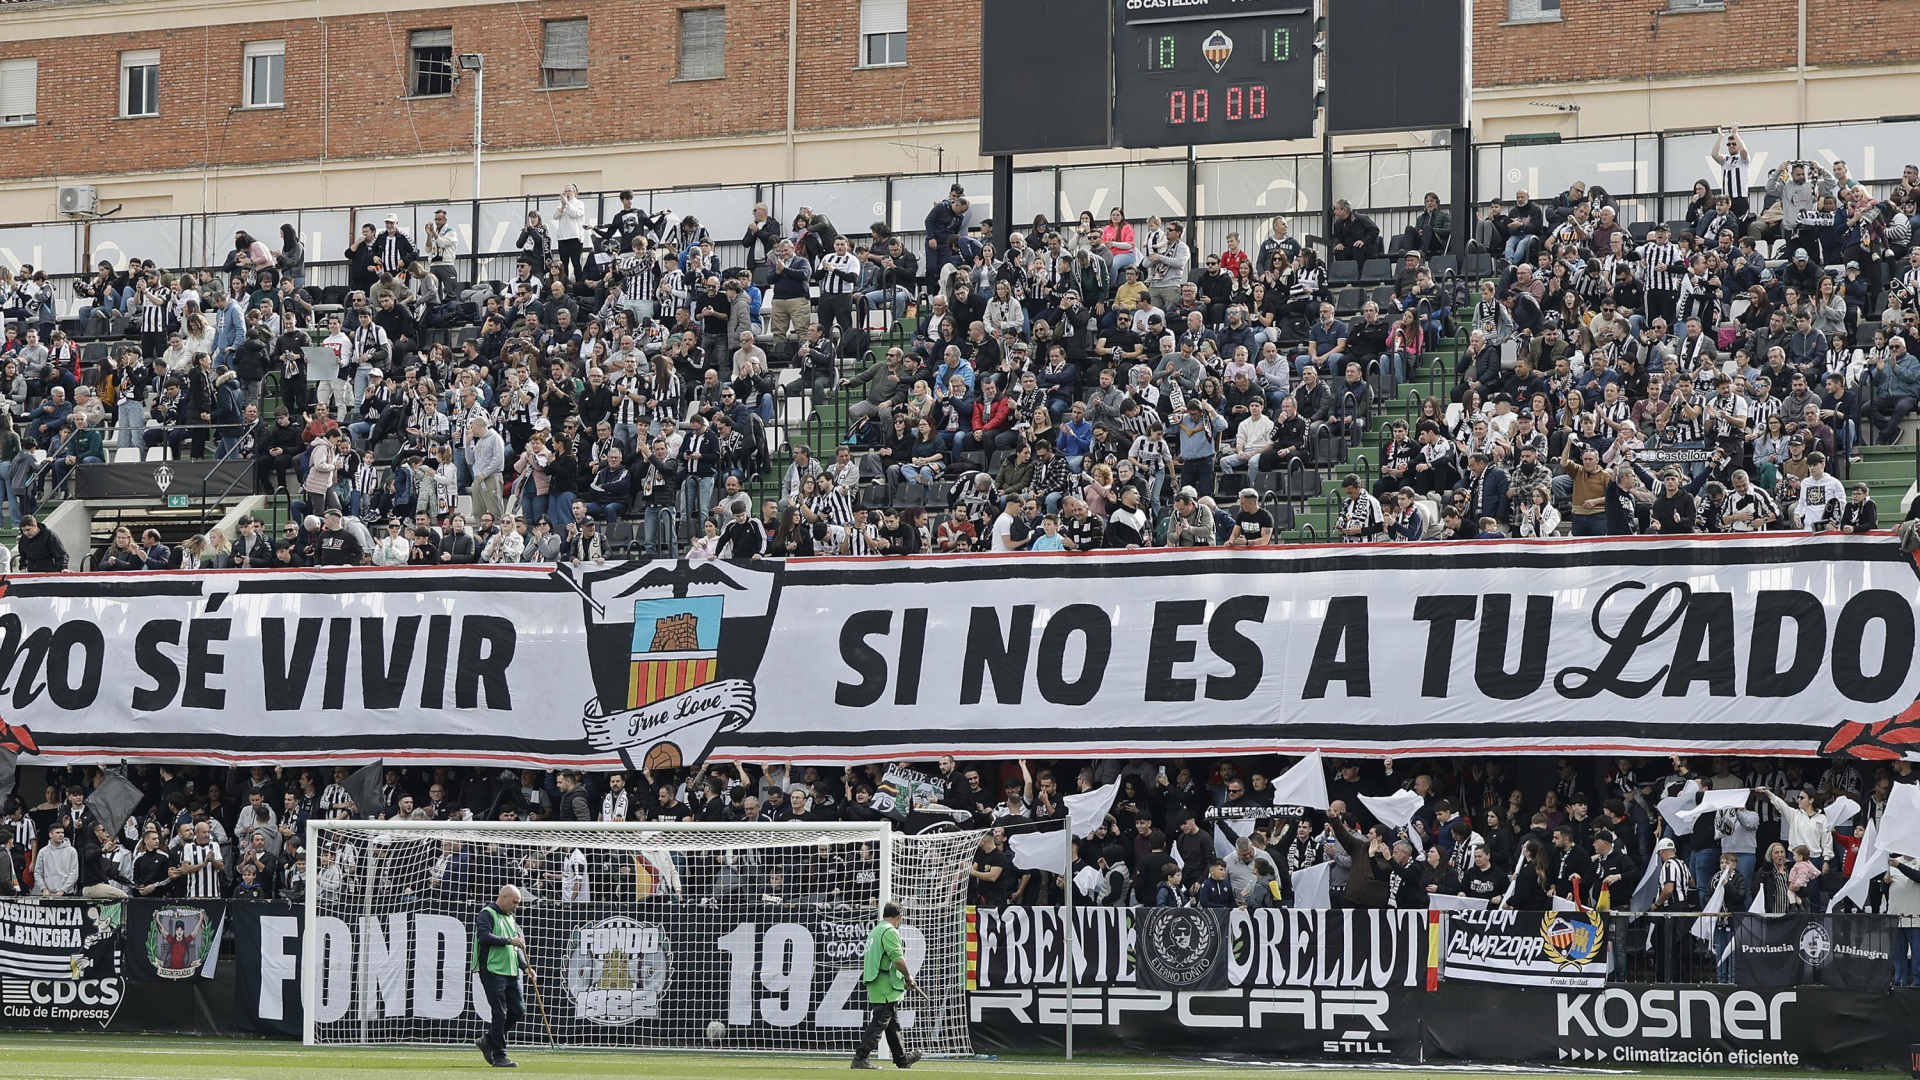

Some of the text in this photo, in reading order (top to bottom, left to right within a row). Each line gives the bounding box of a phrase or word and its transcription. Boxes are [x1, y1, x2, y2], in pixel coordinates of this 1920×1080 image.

[1126, 0, 1142, 10] CD
[1159, 36, 1174, 68] 0
[1274, 28, 1289, 61] 0
[132, 592, 232, 711] SÉ
[260, 615, 517, 711] VIVIR
[834, 580, 1916, 708] SI NO ES A TU LADO
[627, 693, 722, 737] True Love
[887, 763, 927, 783] FRENTE
[1204, 806, 1219, 818] MI
[580, 927, 659, 955] FONDO
[978, 906, 1136, 988] FRENTE
[1447, 929, 1545, 966] ALMAZORA
[1741, 943, 1889, 960] Provincia Albinegra
[259, 911, 522, 1024] FOND
[1151, 957, 1180, 981] ETERNO
[30, 978, 120, 1006] CDCS
[576, 990, 660, 1019] 1922
[4, 1005, 110, 1021] Club de Empresas
[970, 987, 1389, 1031] REPCAR
[1323, 1041, 1392, 1054] STILL
[1613, 1045, 1799, 1066] Climatización eficiente
